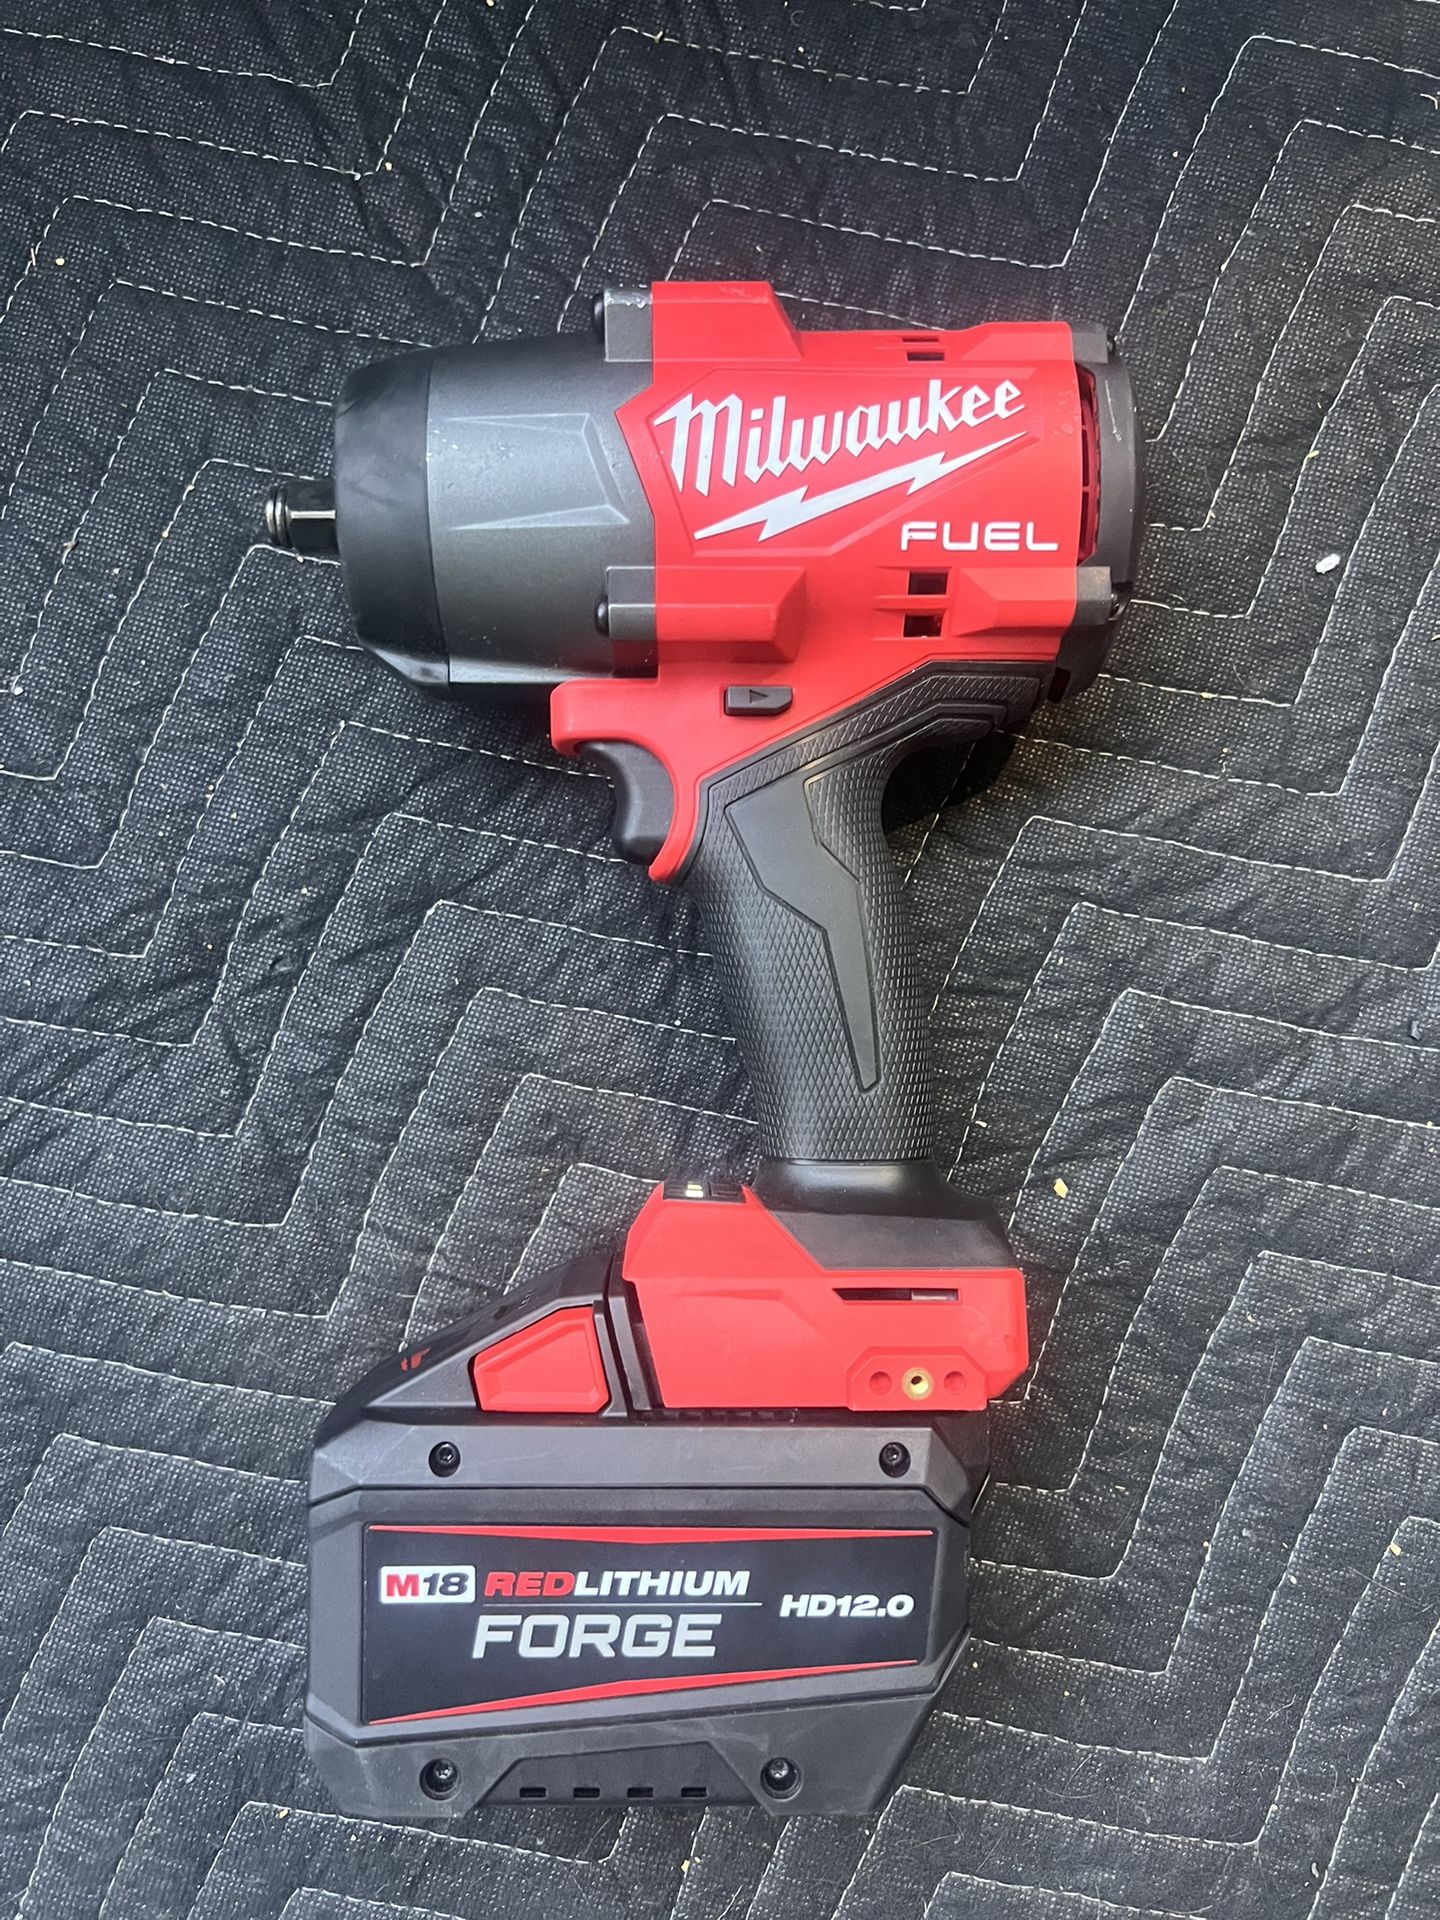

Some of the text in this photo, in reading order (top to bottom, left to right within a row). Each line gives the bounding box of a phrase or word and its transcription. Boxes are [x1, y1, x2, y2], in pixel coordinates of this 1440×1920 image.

[653, 379, 1026, 497] Milwaukee
[900, 521, 1059, 552] FUEL
[385, 1572, 470, 1598] M18
[484, 1570, 751, 1598] REDLITHIUM
[779, 1594, 915, 1619] HD12.0
[472, 1613, 724, 1660] FORGE
